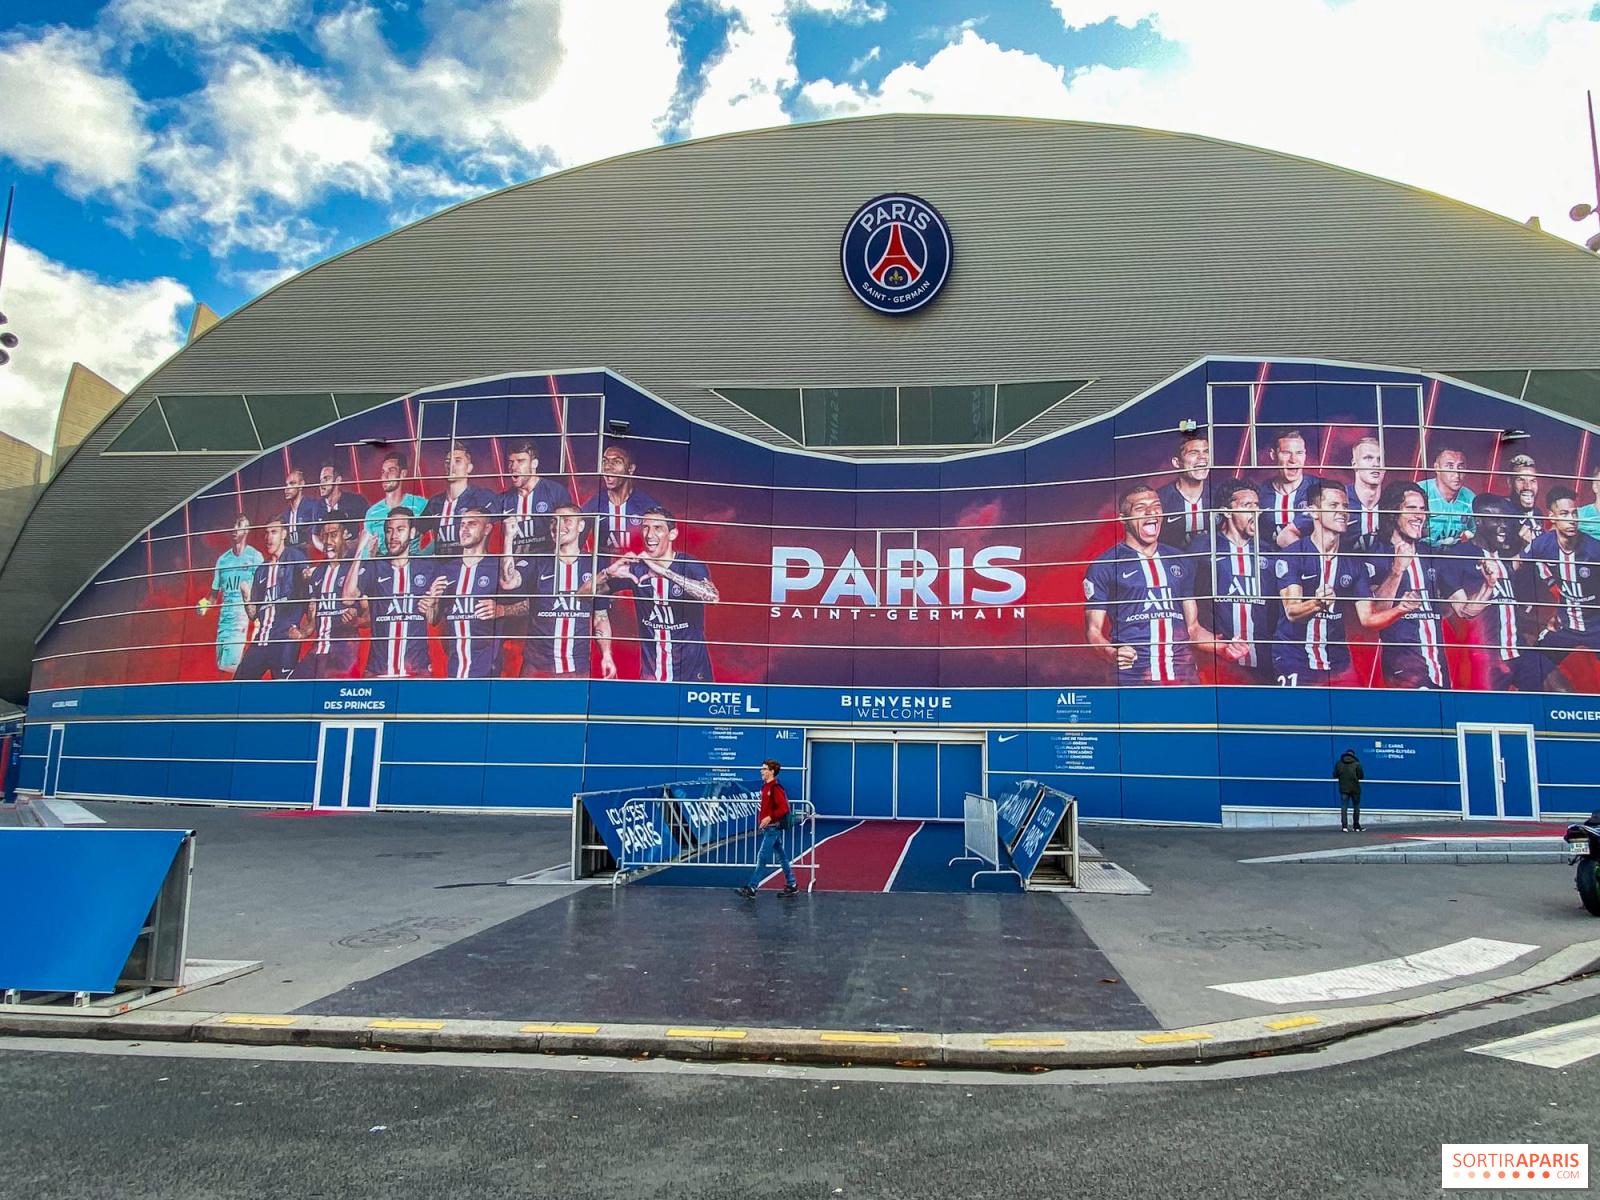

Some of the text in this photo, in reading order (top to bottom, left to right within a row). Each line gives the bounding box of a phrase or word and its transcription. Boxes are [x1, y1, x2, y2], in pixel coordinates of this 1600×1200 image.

[859, 203, 931, 233] PARIS
[770, 545, 1027, 605] PARIS
[339, 687, 372, 697] SALON
[323, 701, 386, 710] DES PRINCES
[687, 691, 760, 713] PORTE L
[841, 695, 952, 708] BIENVENUE
[708, 704, 742, 716] GATE
[857, 708, 935, 719] WELCOME
[1550, 710, 1600, 721] CONCIER
[615, 821, 662, 855] PARIS
